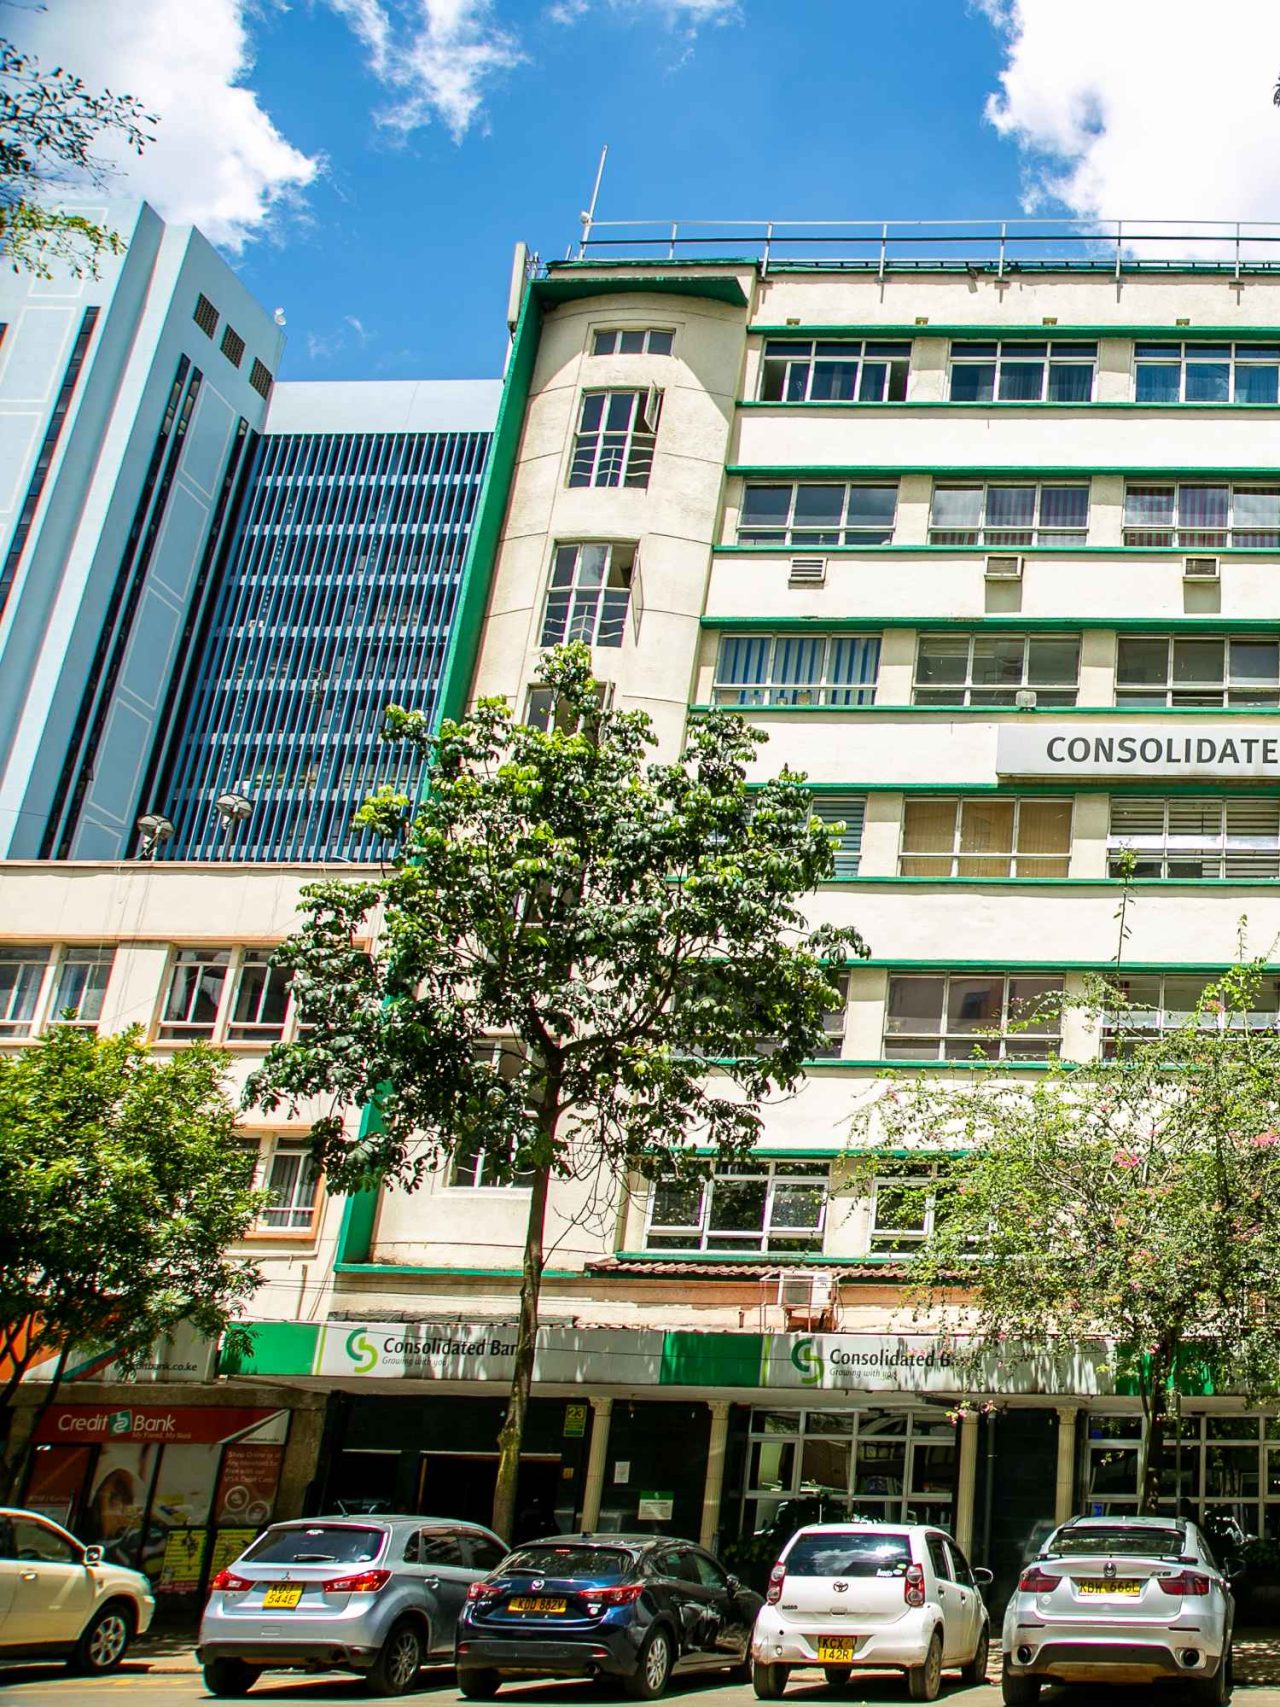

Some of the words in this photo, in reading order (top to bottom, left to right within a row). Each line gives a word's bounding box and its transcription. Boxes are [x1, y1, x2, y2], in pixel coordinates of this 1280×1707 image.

[383, 1338, 485, 1355] Consolidated
[490, 1340, 518, 1355] Ban
[829, 1349, 934, 1366] Consolidated
[568, 1408, 584, 1419] 23
[58, 1414, 108, 1431] Credit
[133, 1416, 176, 1432] Bank
[822, 1637, 845, 1649] KCX
[822, 1650, 850, 1660] 142R
